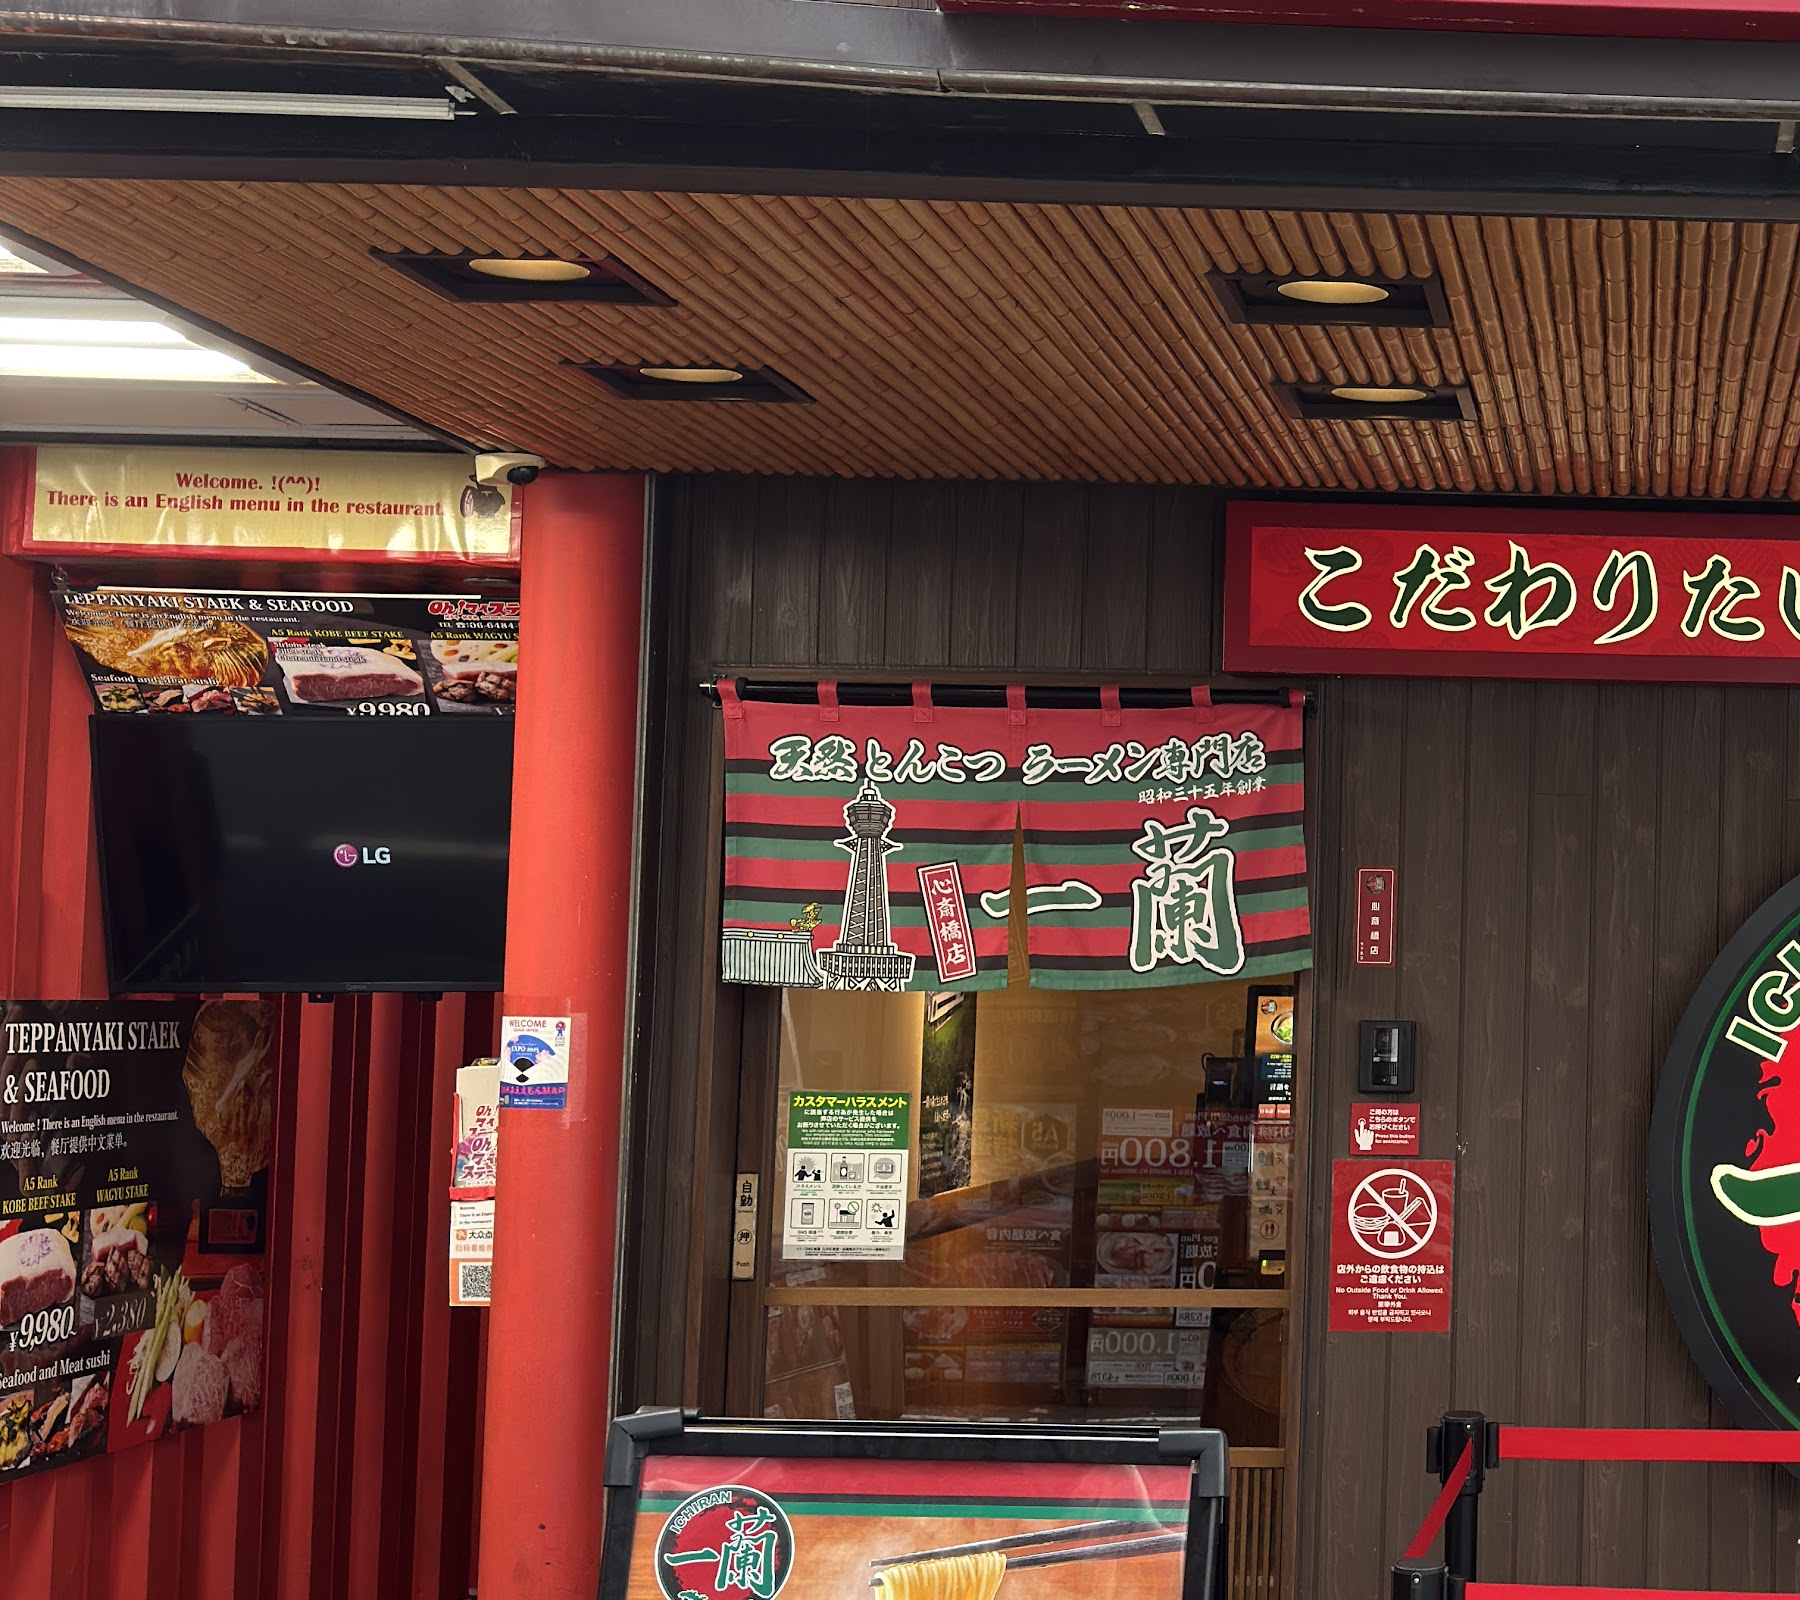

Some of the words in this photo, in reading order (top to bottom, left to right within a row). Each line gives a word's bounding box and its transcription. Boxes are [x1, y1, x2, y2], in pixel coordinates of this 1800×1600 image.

[176, 472, 263, 490] Welcome.
[47, 490, 98, 506] There
[105, 492, 118, 507] is
[125, 495, 148, 507] an
[156, 493, 222, 512] English
[230, 498, 280, 511] menu
[287, 497, 304, 512] in
[311, 499, 339, 513] the
[249, 598, 262, 610] &
[268, 598, 354, 613] SEAFOOD
[271, 629, 286, 637] A5
[287, 629, 312, 638] Rank
[314, 629, 343, 638] KOBE
[344, 630, 370, 638] BEEF
[370, 631, 405, 639] STAKE
[430, 631, 444, 639] A5
[445, 631, 472, 640] Rank
[473, 632, 510, 640] WAGYU
[90, 673, 135, 684] Seafood
[137, 674, 156, 685] and
[769, 733, 1007, 784] 天然とんこつ
[1021, 731, 1269, 786] ラーメン専門店
[1137, 778, 1268, 806] 昭和三十五年創業
[363, 844, 391, 865] LG
[980, 806, 1247, 976] 一蘭
[930, 875, 968, 968] 心斎橋店
[509, 1019, 547, 1028] WELCOME
[5, 1022, 124, 1054] TEPPANYAKI
[128, 1021, 181, 1050] STAEK
[3, 1074, 18, 1104] &
[24, 1069, 111, 1103] SEAFOOD
[793, 1095, 907, 1109] カスタマーハラスメント
[1, 1119, 36, 1134] Welcome
[42, 1118, 63, 1131] There
[63, 1117, 70, 1130] is
[71, 1118, 80, 1128] an
[81, 1114, 106, 1130] English
[1368, 1123, 1411, 1131] お呼びください
[23, 1177, 36, 1191] A5
[37, 1175, 58, 1189] Rank
[108, 1168, 119, 1182] A5
[120, 1166, 139, 1180] Rank
[96, 1187, 124, 1203] WAGYU
[125, 1184, 149, 1198] STAKE
[740, 1180, 753, 1207] 自動
[2, 1199, 27, 1215] KOBE
[28, 1196, 49, 1211] BEEF
[50, 1192, 77, 1208] STAKE
[740, 1231, 750, 1242] 押
[1336, 1264, 1445, 1275] 店外からの飲食物の持込は
[1359, 1275, 1422, 1284] ご遠慮ください
[1335, 1286, 1345, 1294] No
[1346, 1286, 1371, 1294] Outside
[1372, 1286, 1389, 1294] Food
[38, 1361, 58, 1381] and
[59, 1358, 84, 1376] Meat
[85, 1349, 111, 1371] sushi
[669, 1490, 733, 1535] ICHIRAN
[663, 1506, 777, 1599] 一蘭
